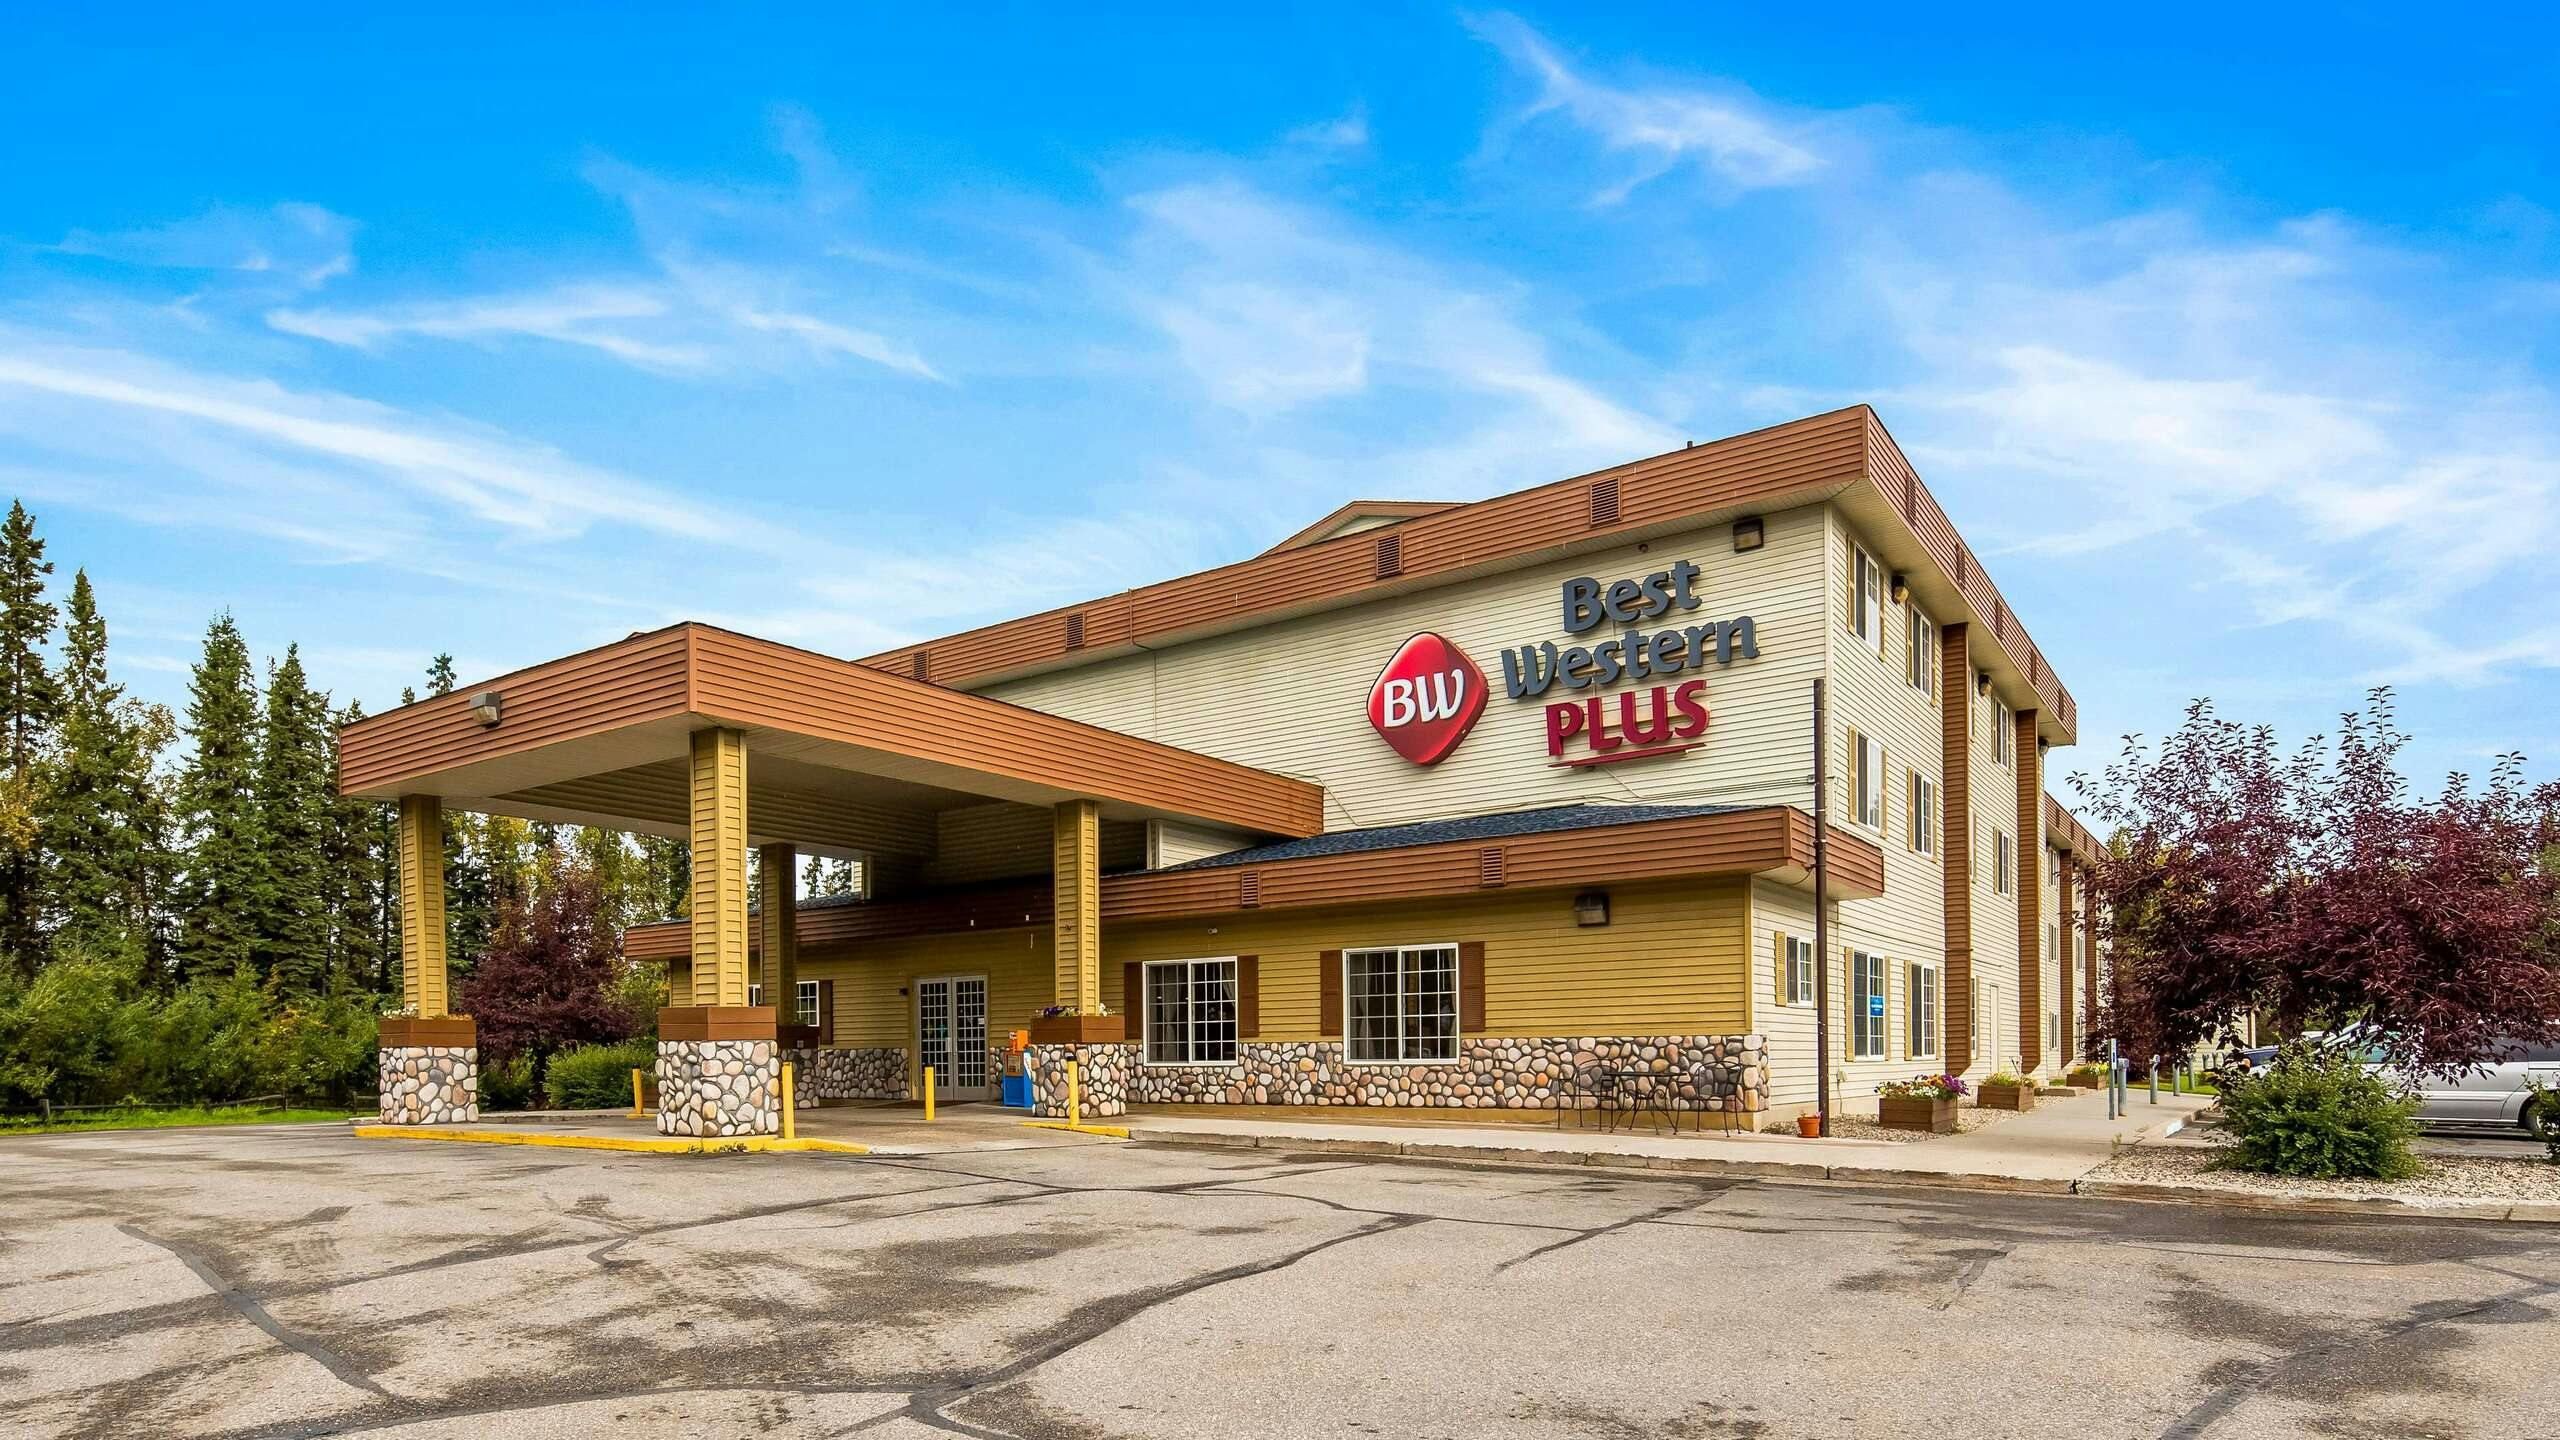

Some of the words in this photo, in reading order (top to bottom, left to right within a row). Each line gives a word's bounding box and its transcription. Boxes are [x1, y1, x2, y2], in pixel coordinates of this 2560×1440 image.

[1562, 560, 1702, 634] Best
[1501, 615, 1760, 699] Western
[1383, 669, 1465, 728] BW
[1546, 680, 1709, 757] PLUS
